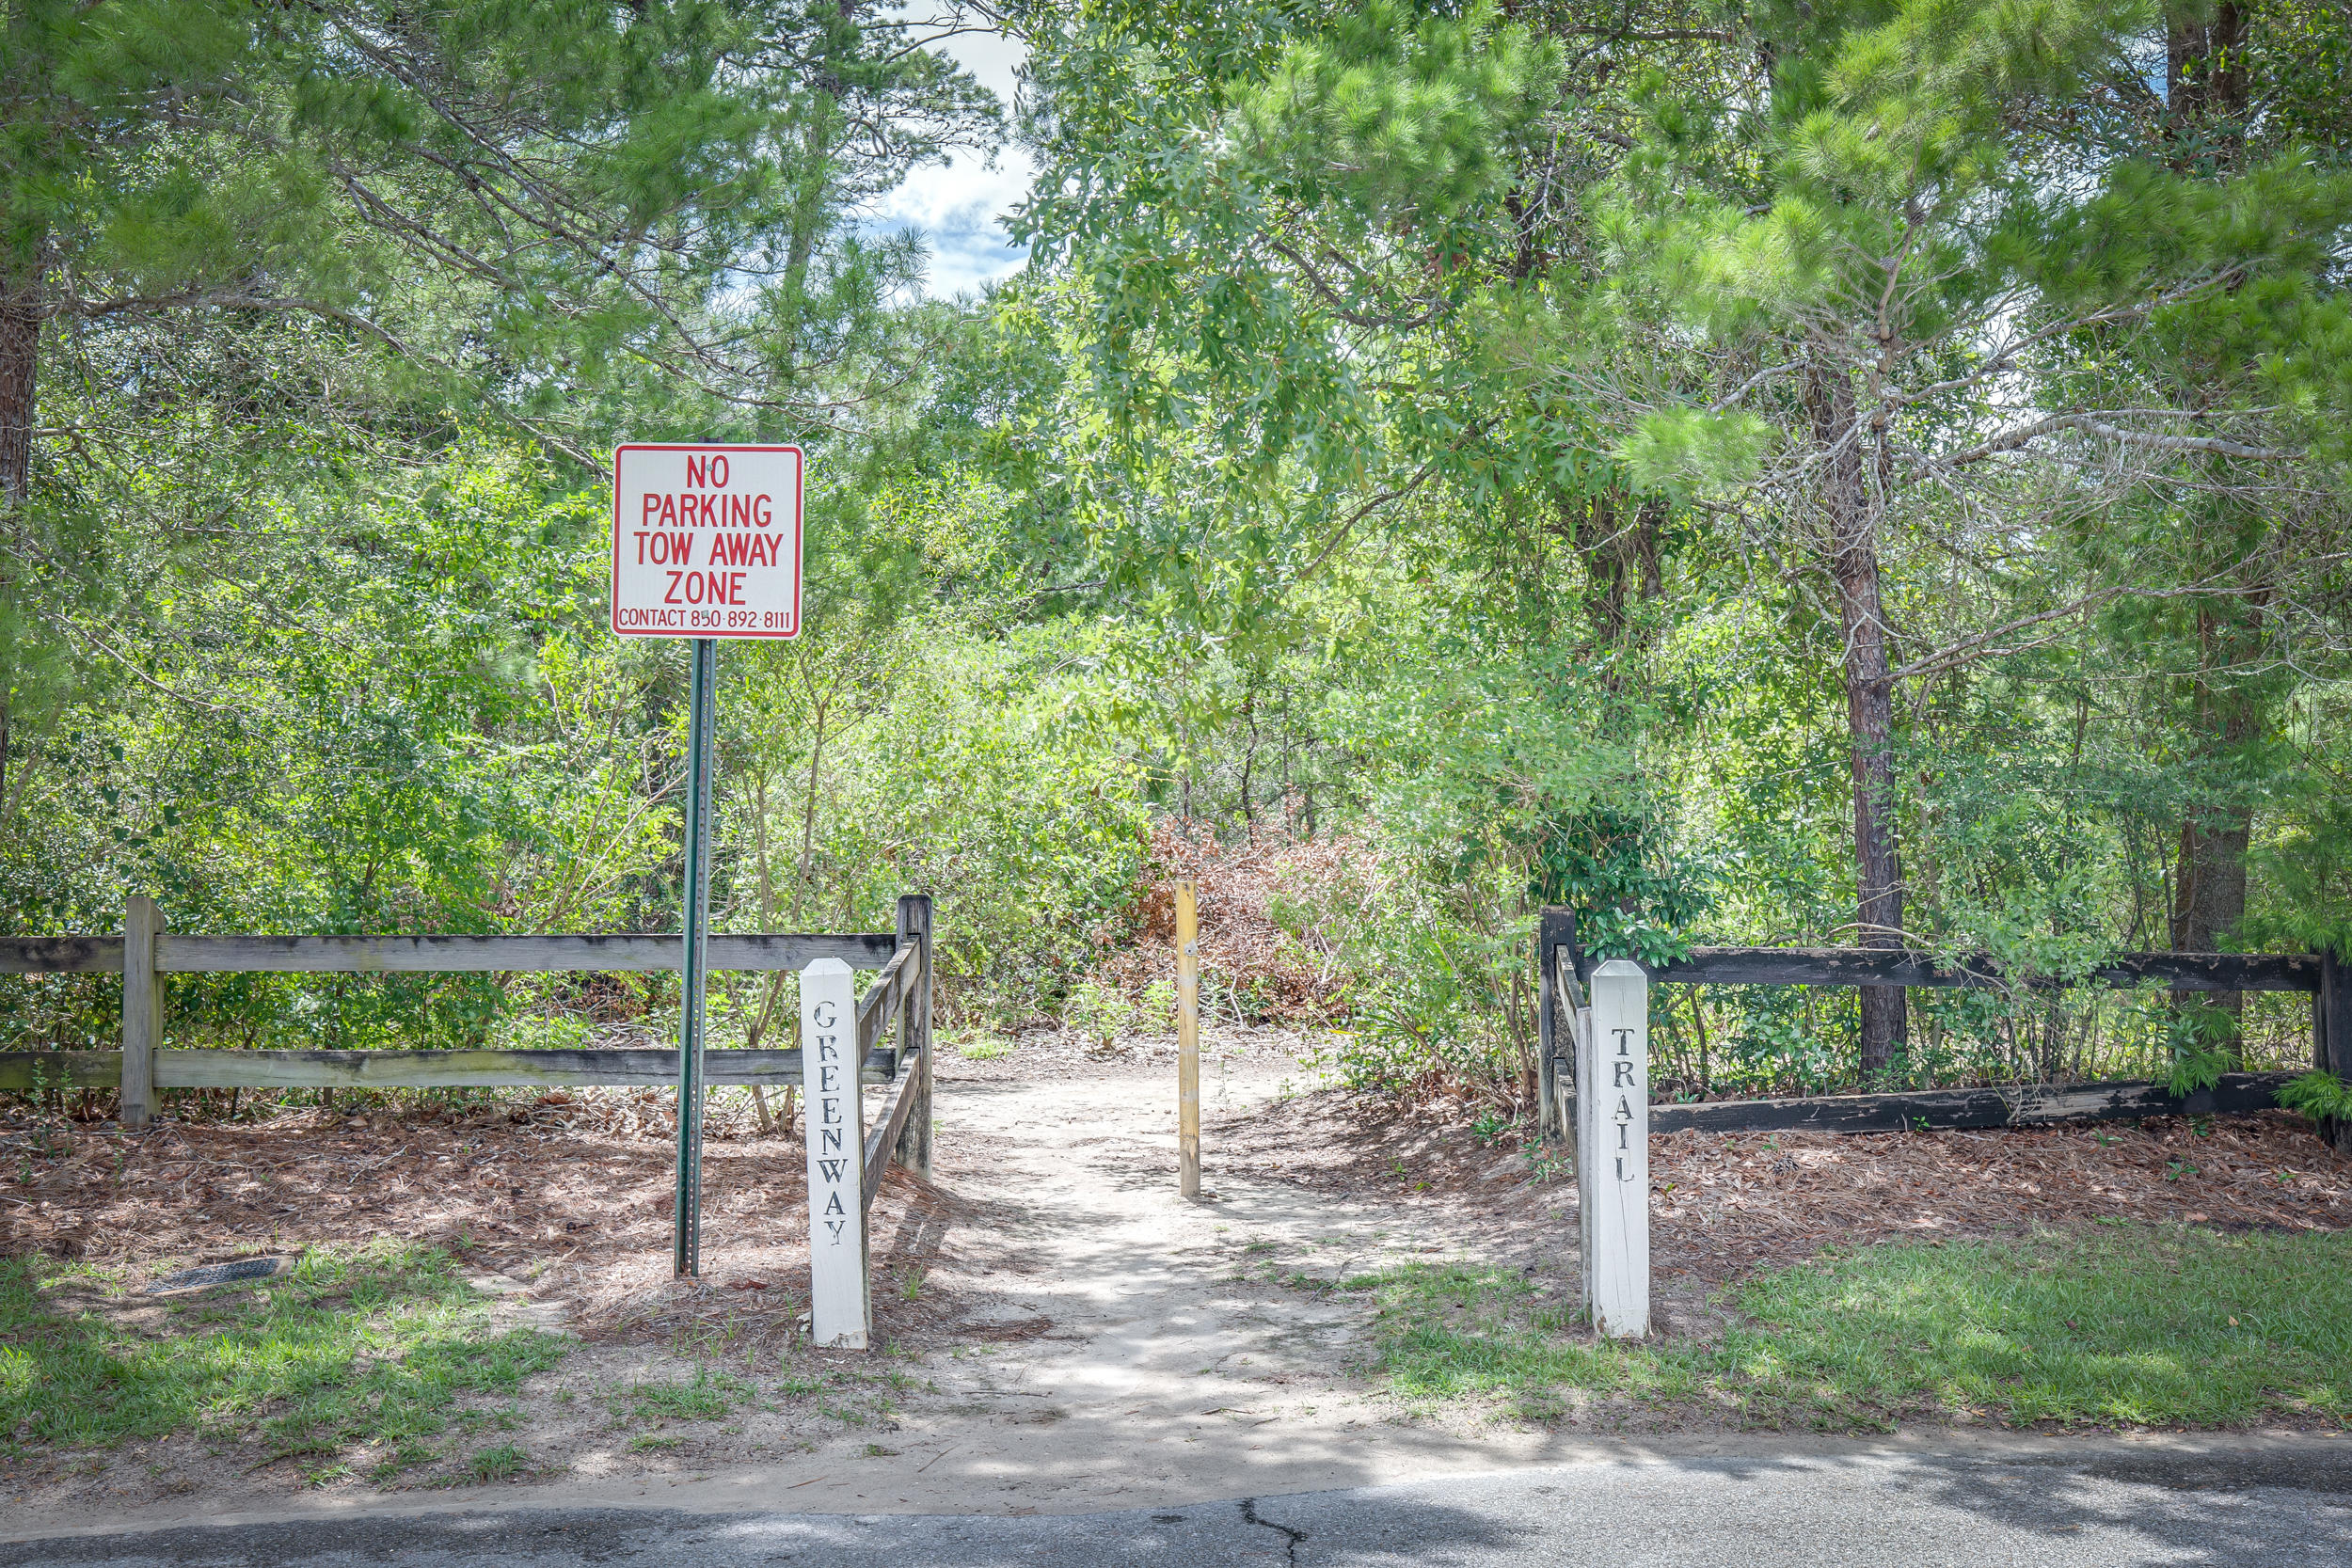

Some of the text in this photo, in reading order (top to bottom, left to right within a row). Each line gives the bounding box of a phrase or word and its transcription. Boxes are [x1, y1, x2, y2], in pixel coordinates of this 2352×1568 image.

[687, 454, 729, 488] NO
[643, 493, 771, 528] PARKING
[633, 531, 784, 567] TOW AWAY
[664, 571, 747, 605] ZONE
[618, 608, 686, 627] CONTACT
[1611, 1028, 1636, 1182] TRAIL
[813, 1000, 849, 1246] GREENWAY
